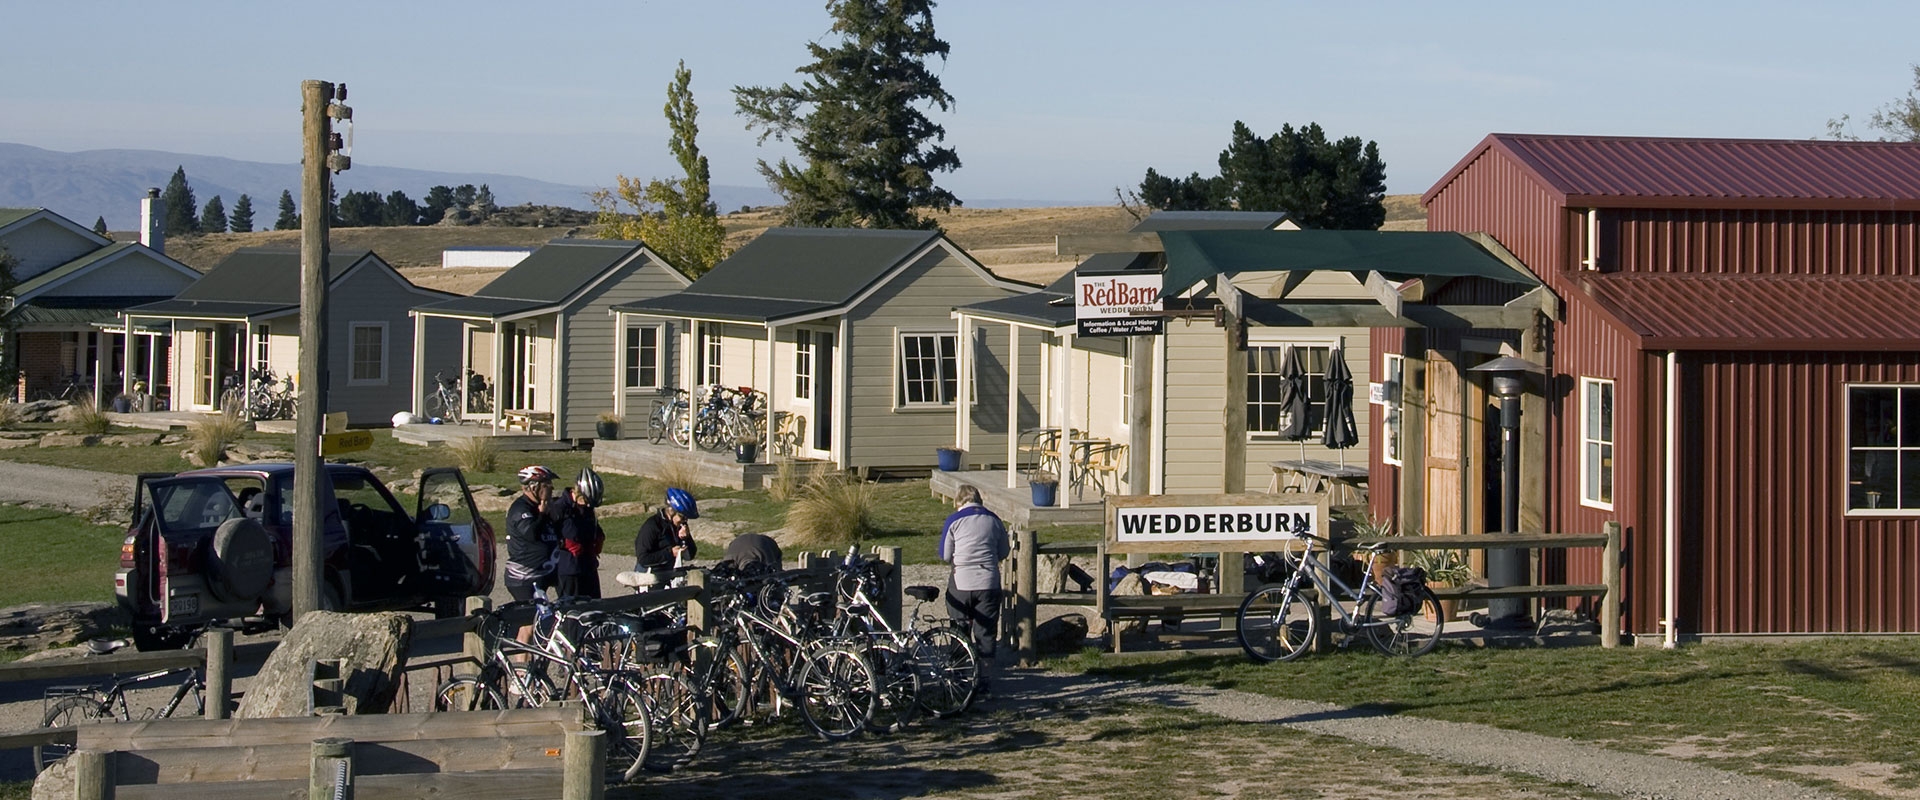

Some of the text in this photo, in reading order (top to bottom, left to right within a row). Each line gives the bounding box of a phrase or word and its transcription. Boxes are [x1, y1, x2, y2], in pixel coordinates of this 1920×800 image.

[338, 435, 370, 448] Red Barn
[1121, 512, 1311, 534] WEDDERBURN
